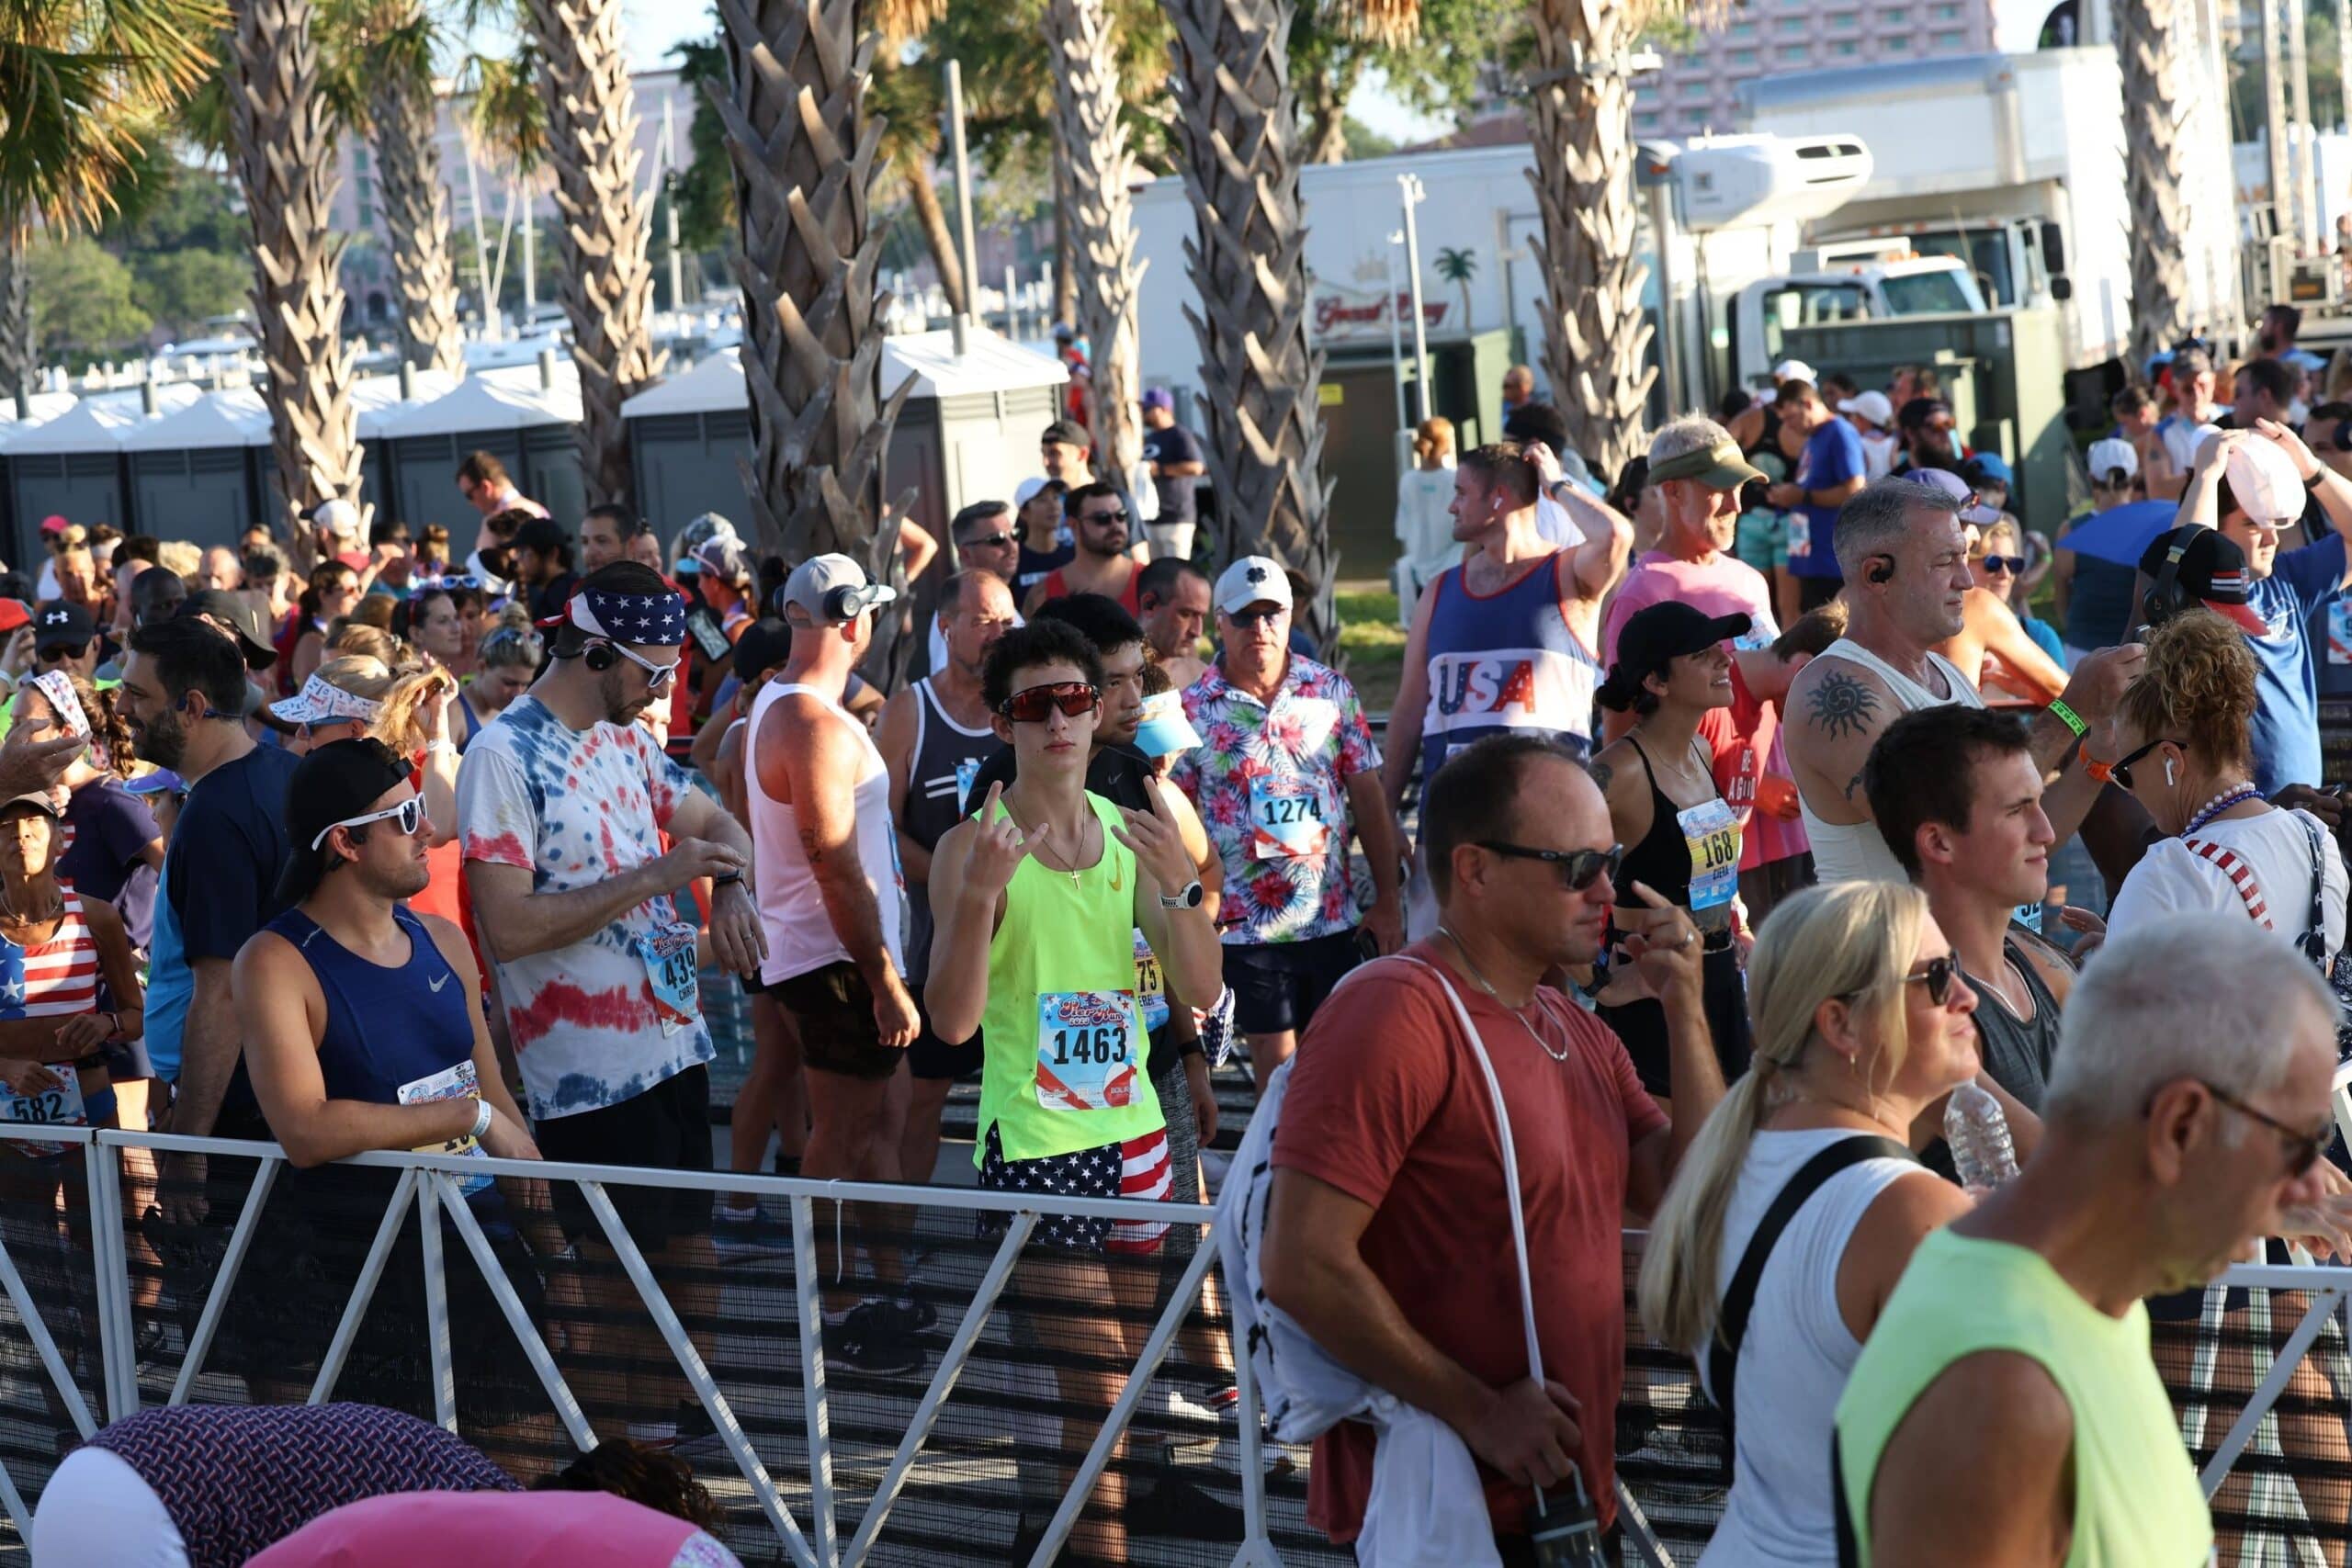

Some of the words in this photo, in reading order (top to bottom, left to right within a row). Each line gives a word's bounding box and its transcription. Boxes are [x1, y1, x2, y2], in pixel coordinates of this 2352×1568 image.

[1439, 660, 1535, 716] USA
[1264, 796, 1322, 825] 1274
[1702, 829, 1734, 868] 168
[664, 945, 697, 989] 439
[678, 982, 695, 1001] CHRIS
[1057, 998, 1096, 1021] Pier
[1091, 1000, 1124, 1025] Run
[1053, 1027, 1126, 1065] 1463
[13, 1093, 66, 1122] 582
